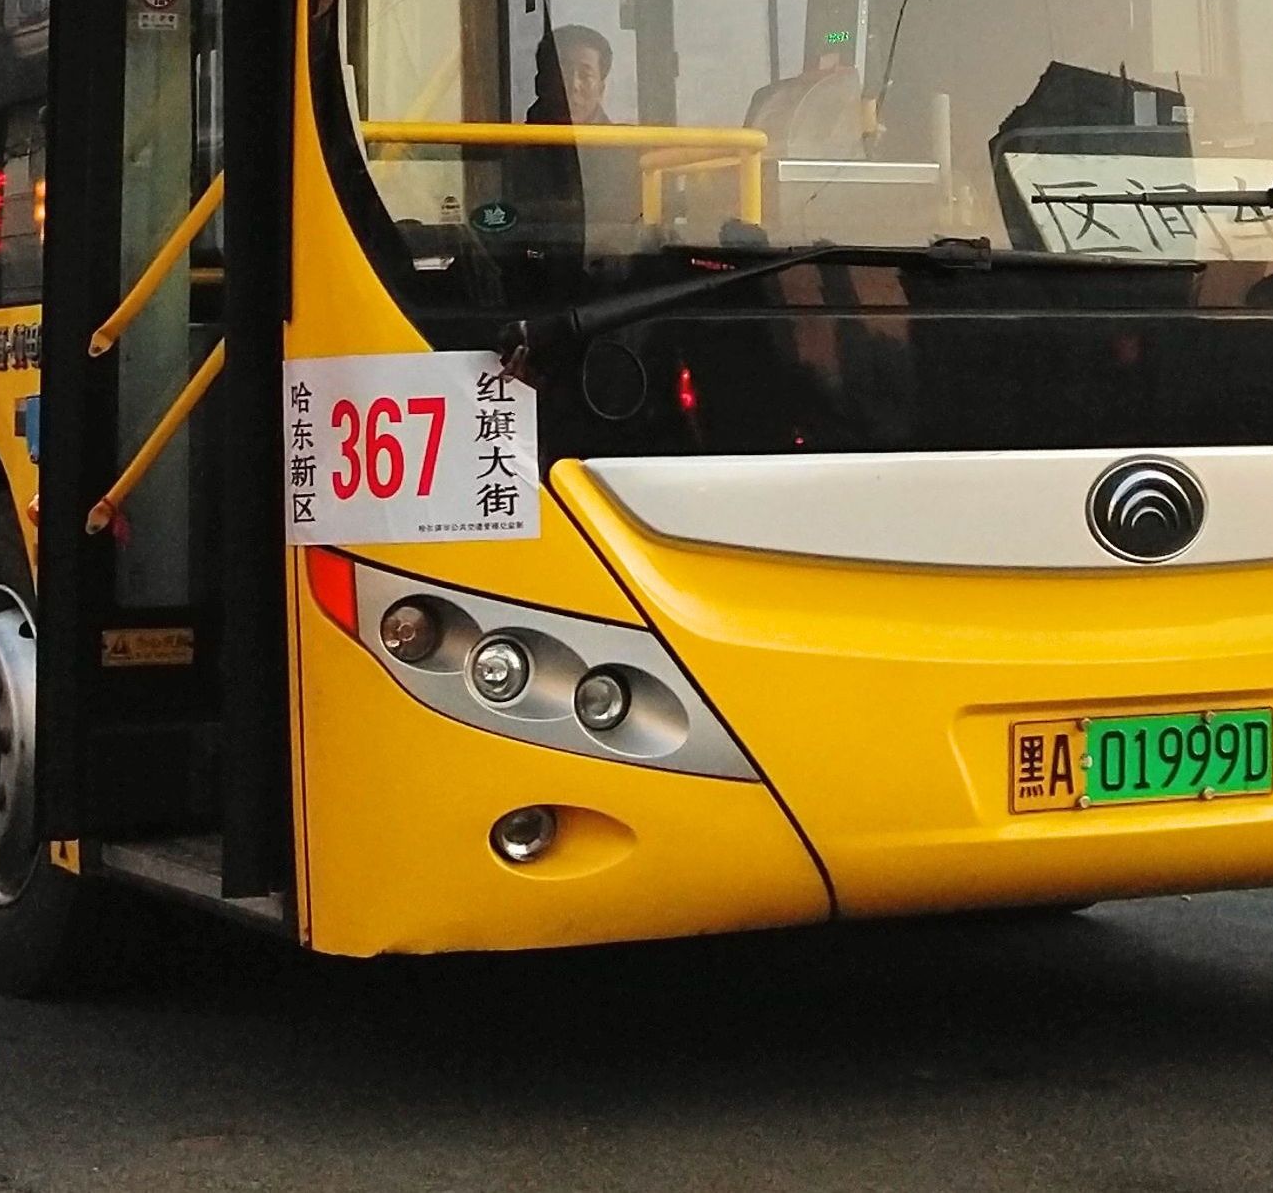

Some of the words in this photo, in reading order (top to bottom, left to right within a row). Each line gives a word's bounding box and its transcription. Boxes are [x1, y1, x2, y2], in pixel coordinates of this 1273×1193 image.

[291, 381, 317, 524] 哈东新区
[331, 397, 446, 500] 367
[474, 371, 521, 518] 红旗大街
